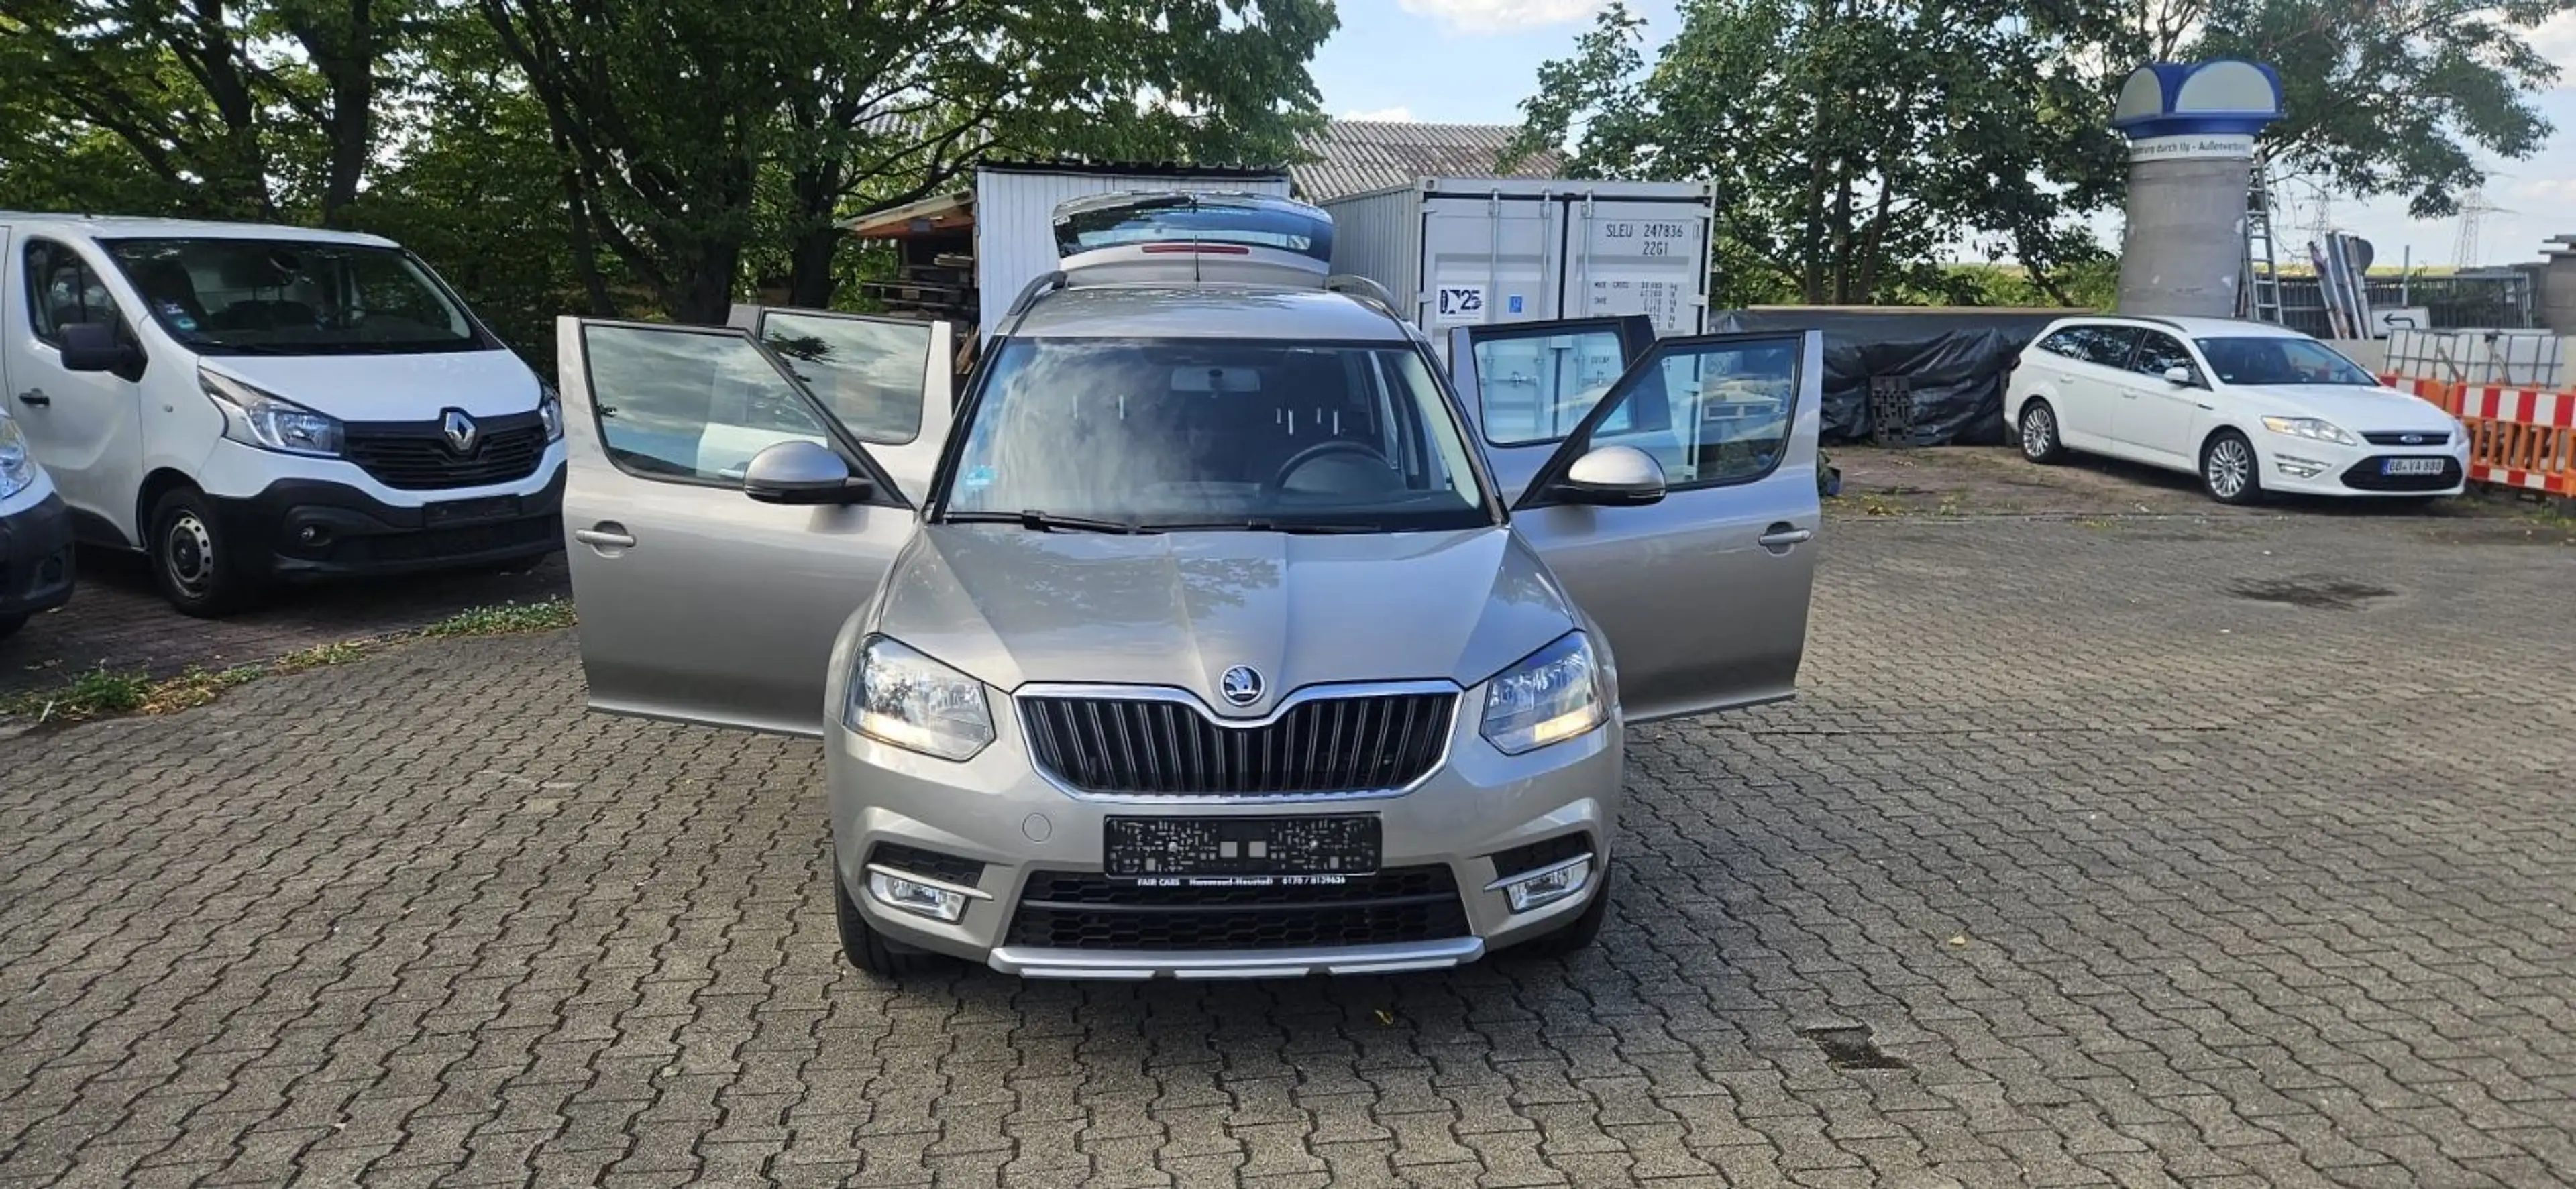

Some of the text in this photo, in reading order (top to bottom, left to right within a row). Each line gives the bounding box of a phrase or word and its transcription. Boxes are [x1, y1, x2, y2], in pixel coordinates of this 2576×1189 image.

[1606, 223, 1633, 238] SLEU
[1643, 223, 1684, 238] 247836
[1138, 877, 1157, 887] FAIR
[1159, 877, 1180, 887] CARS
